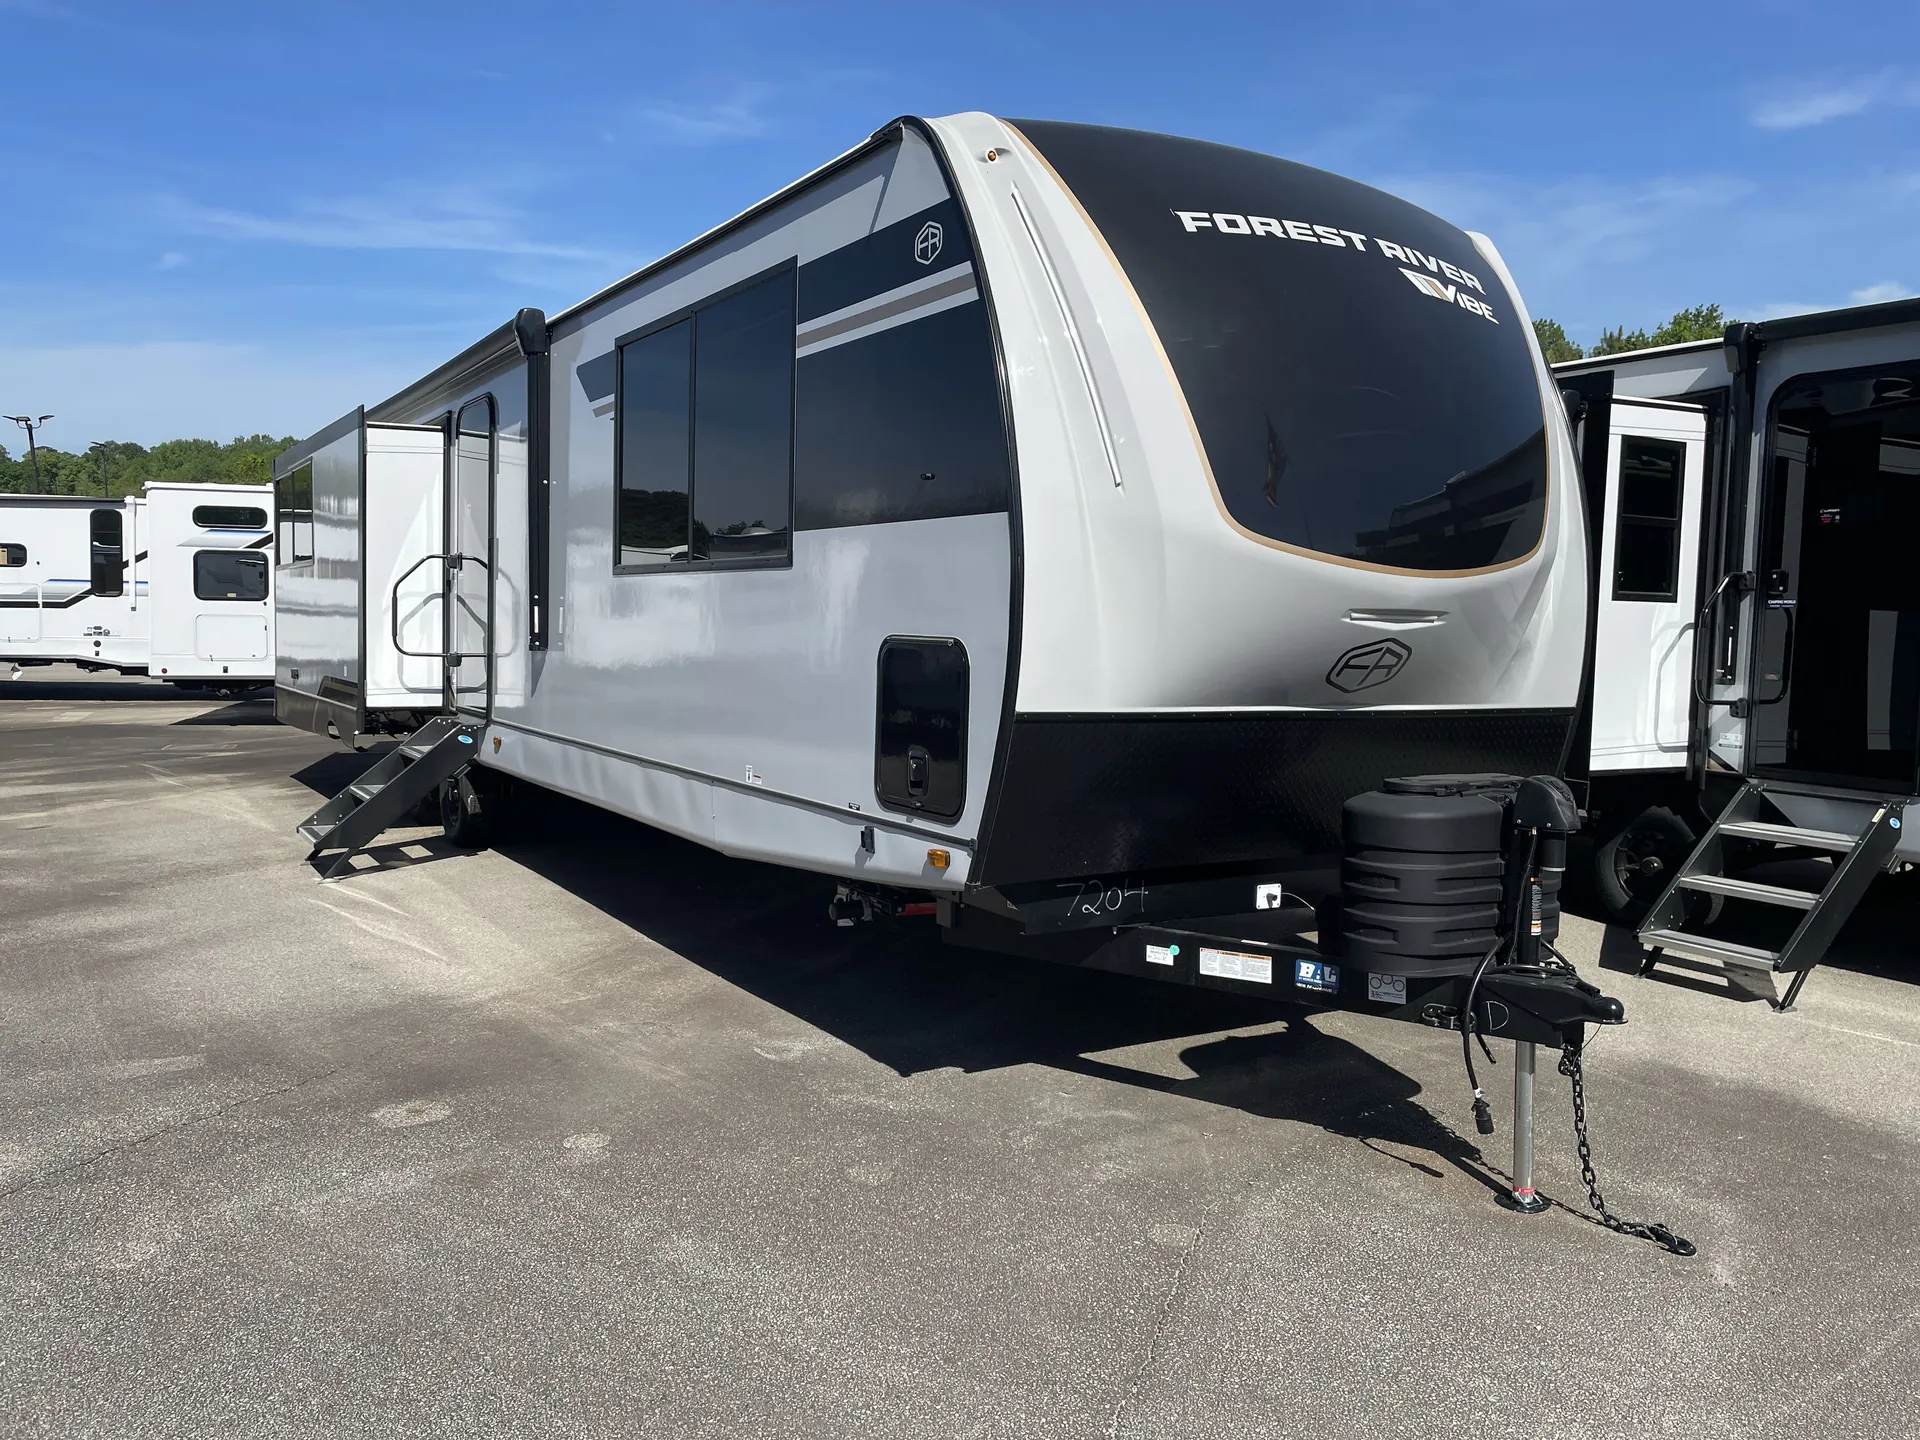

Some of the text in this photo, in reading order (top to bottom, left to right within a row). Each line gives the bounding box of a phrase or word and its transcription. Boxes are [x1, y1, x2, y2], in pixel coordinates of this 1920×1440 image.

[1173, 211, 1487, 296] FOREST RIVER
[1397, 266, 1500, 325] VIBE
[1056, 879, 1149, 915] 7204
[1299, 961, 1337, 983] BAL
[1484, 1000, 1510, 1033] D
